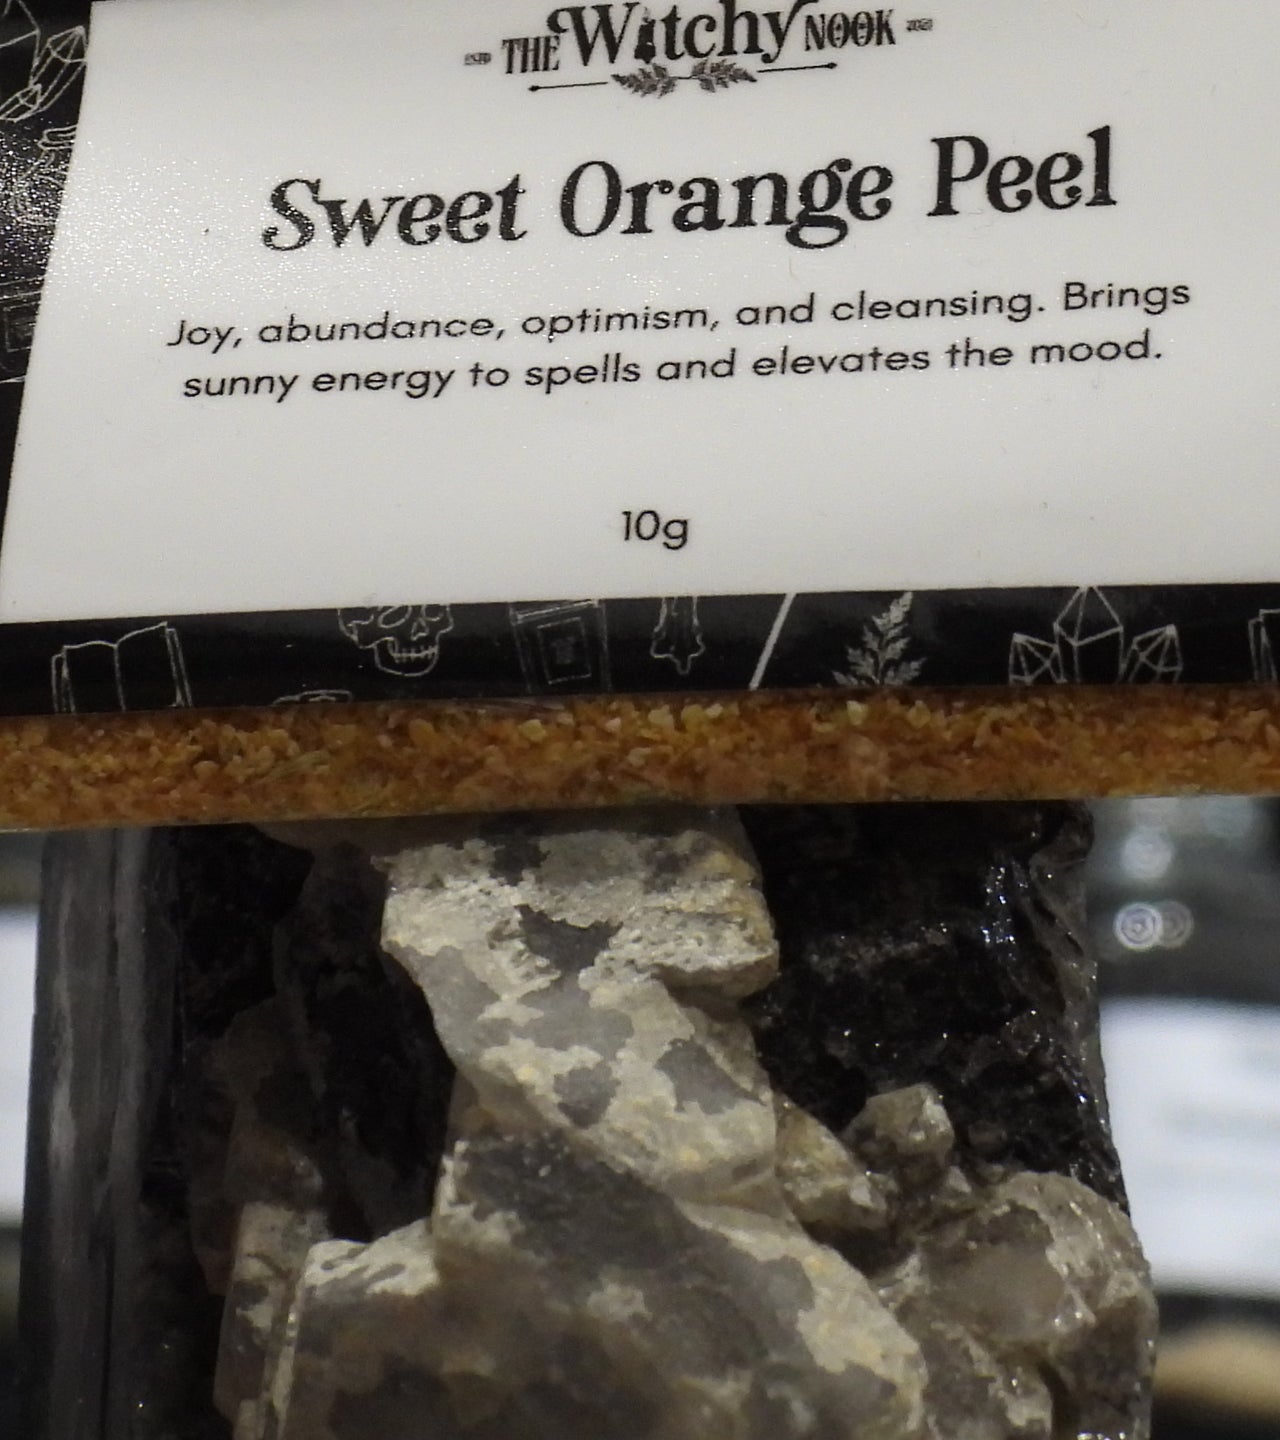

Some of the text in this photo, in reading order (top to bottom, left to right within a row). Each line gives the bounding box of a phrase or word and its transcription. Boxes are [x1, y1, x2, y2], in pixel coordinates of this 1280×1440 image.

[501, 34, 562, 75] THE
[804, 8, 897, 52] NOOK
[261, 124, 1119, 252] Sweet Orange Peel
[167, 281, 1192, 355] Joy, abundance, optimism, and cleansing. Brings
[182, 326, 1163, 405] sunny energy to spells and elevates the mood.
[621, 508, 690, 552] 10g
